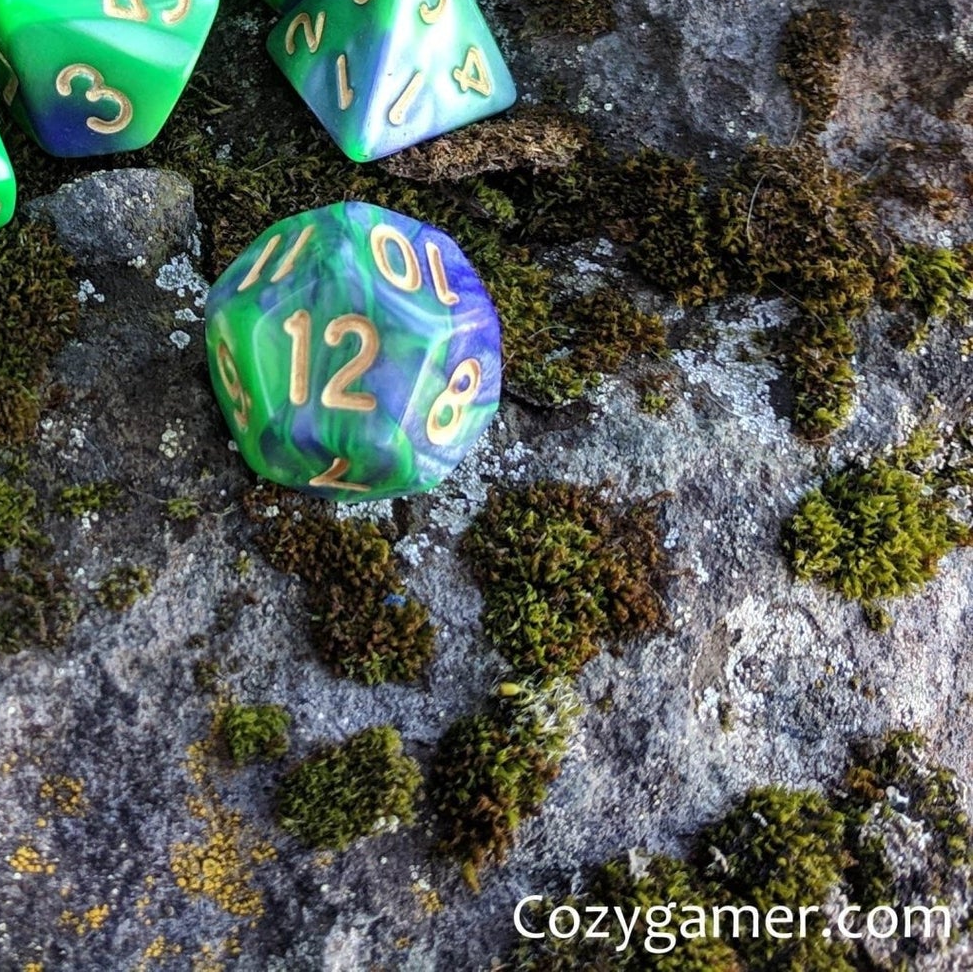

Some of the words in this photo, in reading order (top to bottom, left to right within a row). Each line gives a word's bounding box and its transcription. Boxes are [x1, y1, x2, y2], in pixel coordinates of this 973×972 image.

[285, 11, 326, 56] 2
[55, 63, 134, 135] 3
[452, 46, 493, 97] 4
[237, 224, 315, 292] 11
[283, 309, 380, 411] 12
[426, 357, 482, 446] 8
